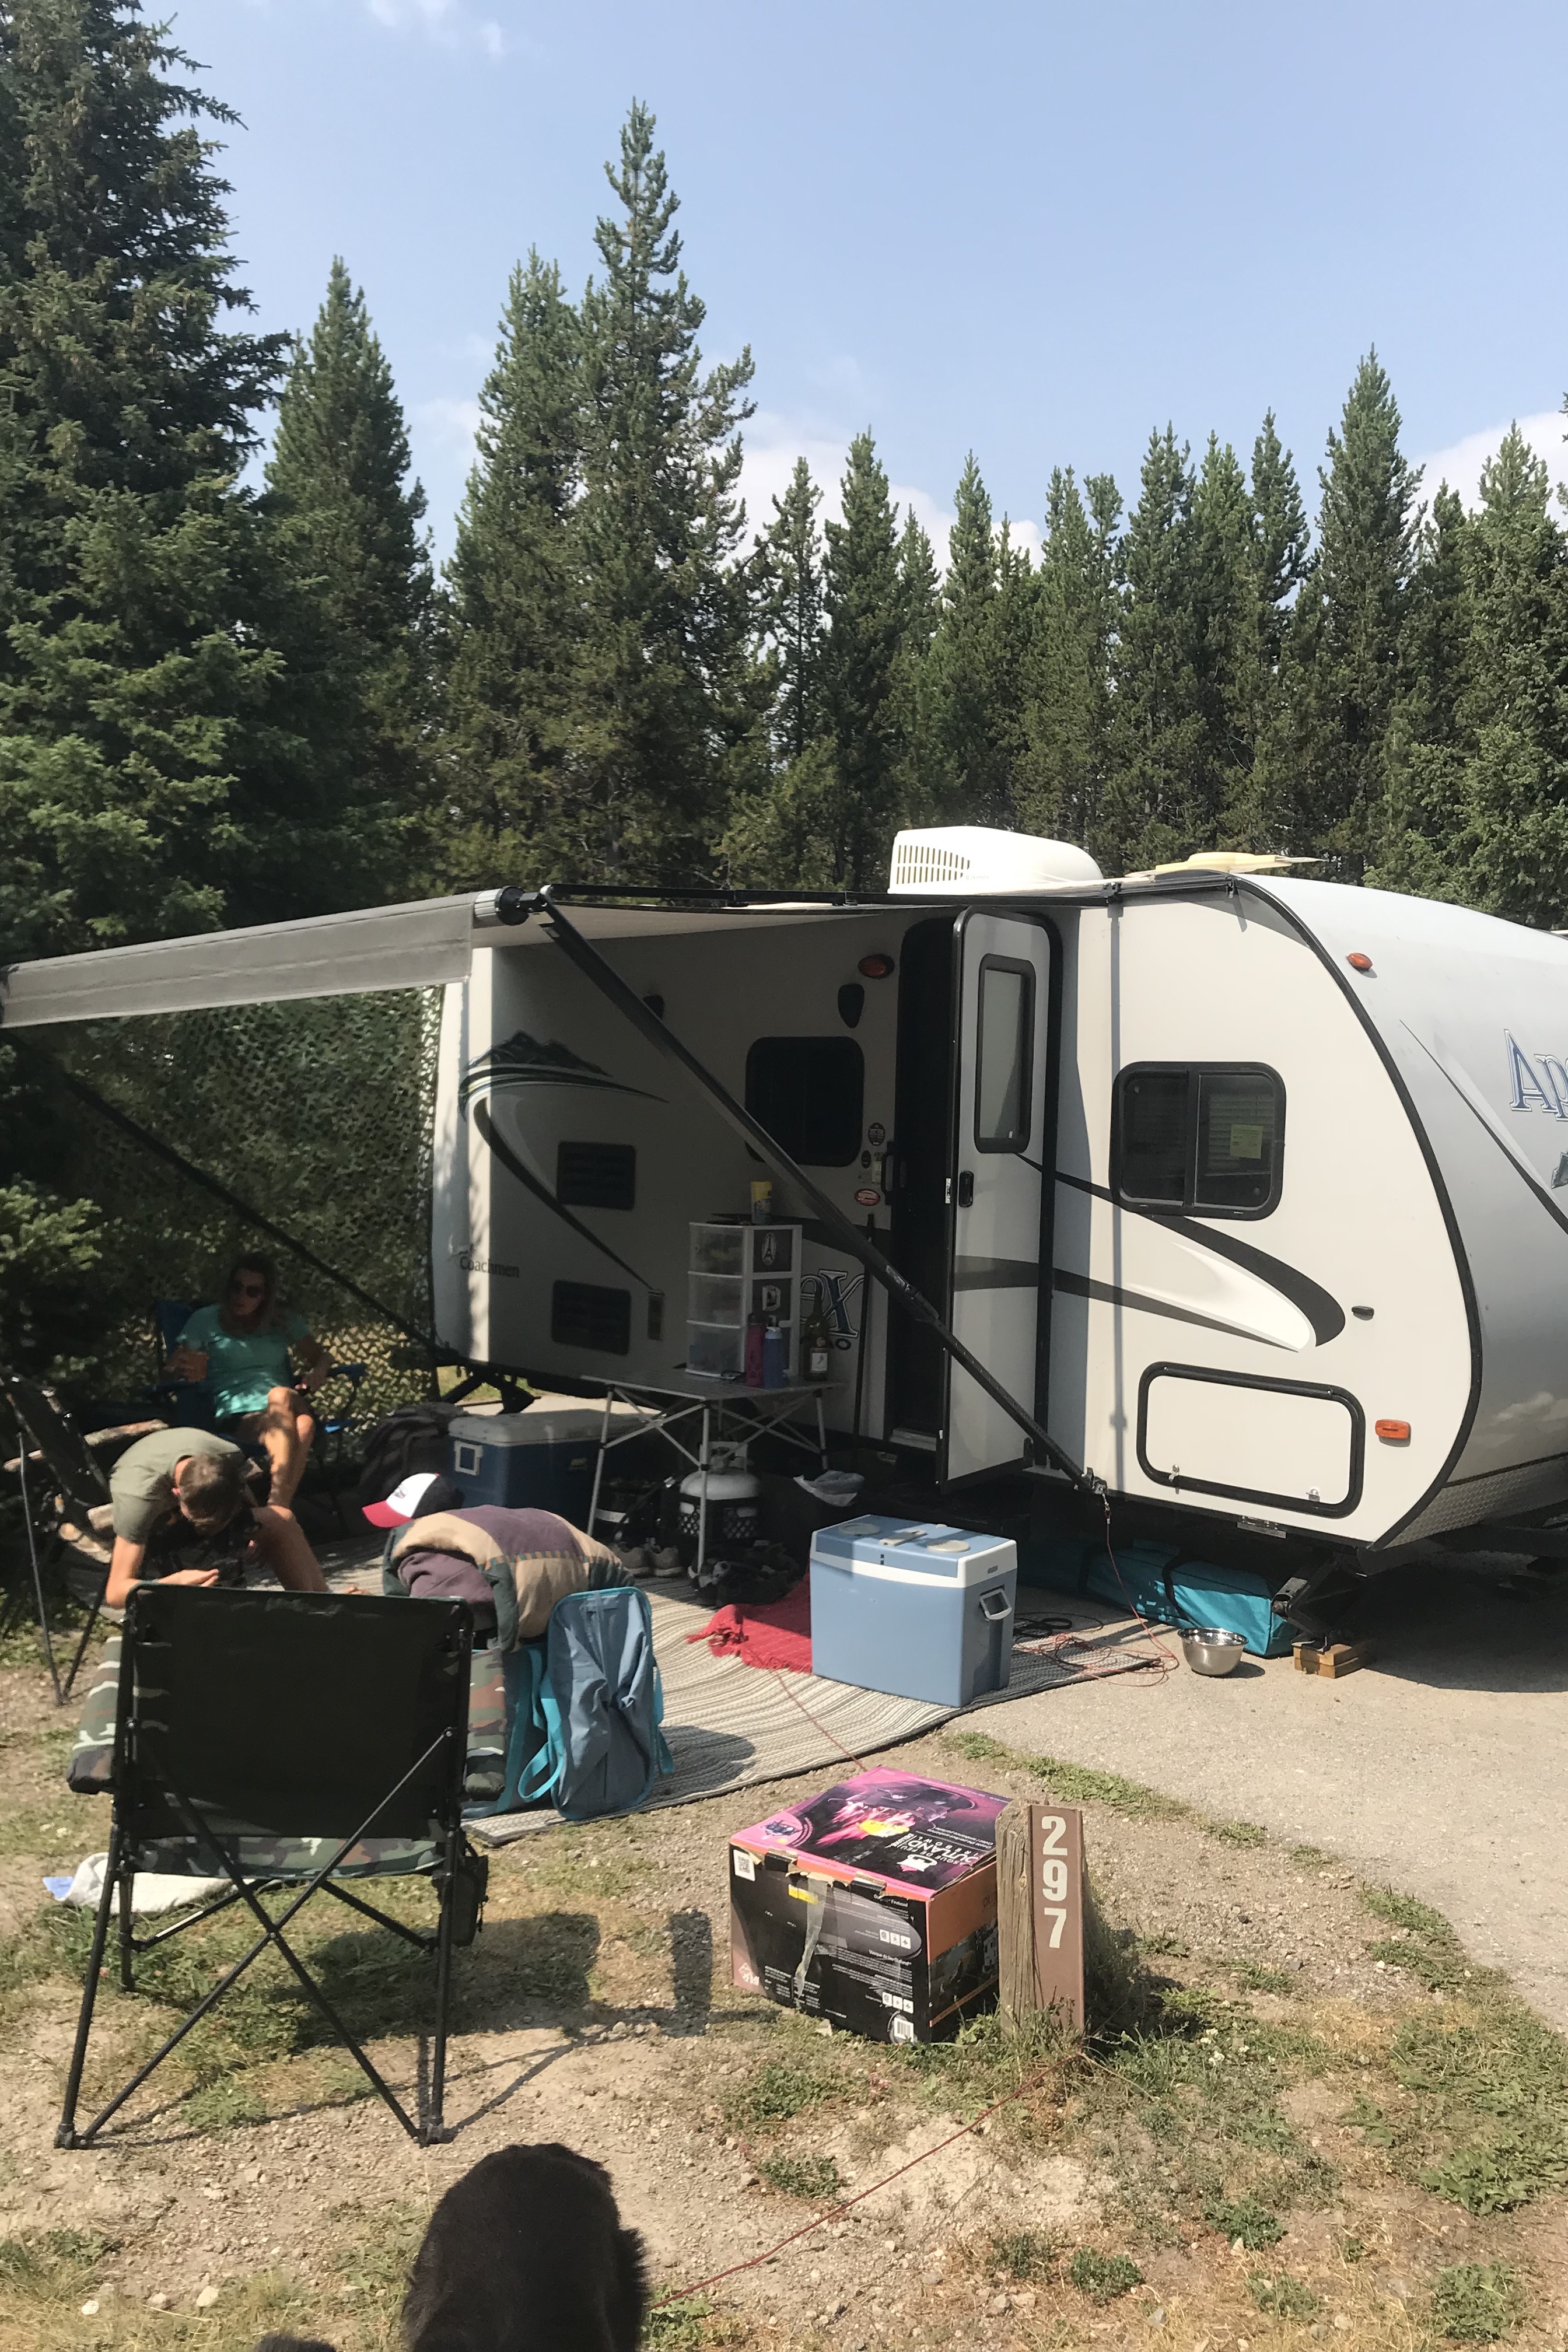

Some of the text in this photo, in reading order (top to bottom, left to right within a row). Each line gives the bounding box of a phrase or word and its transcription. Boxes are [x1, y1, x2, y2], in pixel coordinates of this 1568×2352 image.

[1504, 1028, 1568, 1122] Ap
[460, 1256, 520, 1278] Coachmen
[1041, 1815, 1069, 1949] 297
